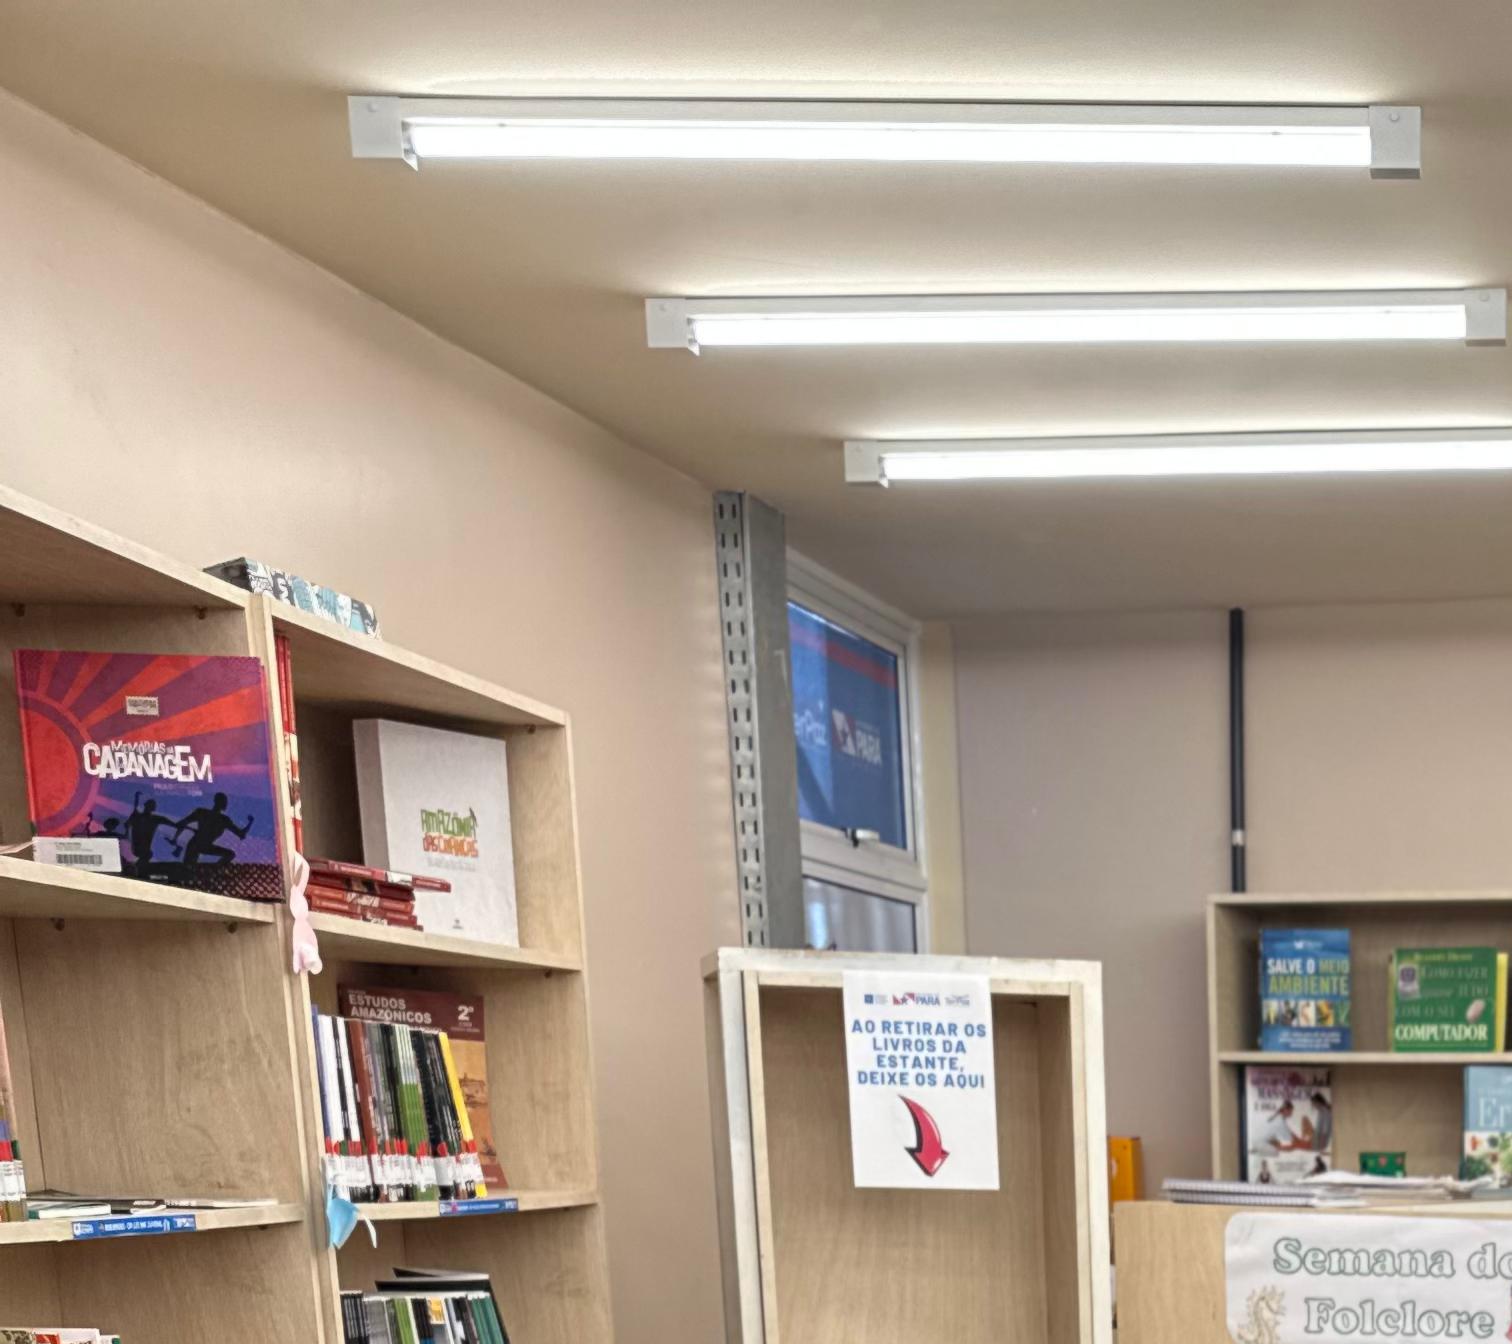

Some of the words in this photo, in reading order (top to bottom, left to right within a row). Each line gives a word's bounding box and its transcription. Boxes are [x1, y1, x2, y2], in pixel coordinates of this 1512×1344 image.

[83, 743, 214, 783] CABANAGEM
[1267, 958, 1302, 975] SALVE
[1306, 958, 1315, 974] O
[1269, 975, 1349, 995] AMBIENTE
[348, 994, 406, 1009] ESTUDOS
[351, 1006, 432, 1024] AMAZÔNICOS
[851, 1020, 876, 1034] AO
[881, 1020, 958, 1037] RETIRAR
[964, 1023, 987, 1038] OS
[1395, 1023, 1488, 1041] COMPUTADOR
[872, 1037, 937, 1053] LIVROS
[942, 1040, 967, 1055] DA
[877, 1054, 965, 1073] ESTANTE,
[858, 1071, 909, 1086] DEIXE
[915, 1073, 937, 1087] OS
[944, 1074, 985, 1089] AQUI
[1272, 1237, 1456, 1278] Semana
[1304, 1297, 1495, 1339] Folclore
